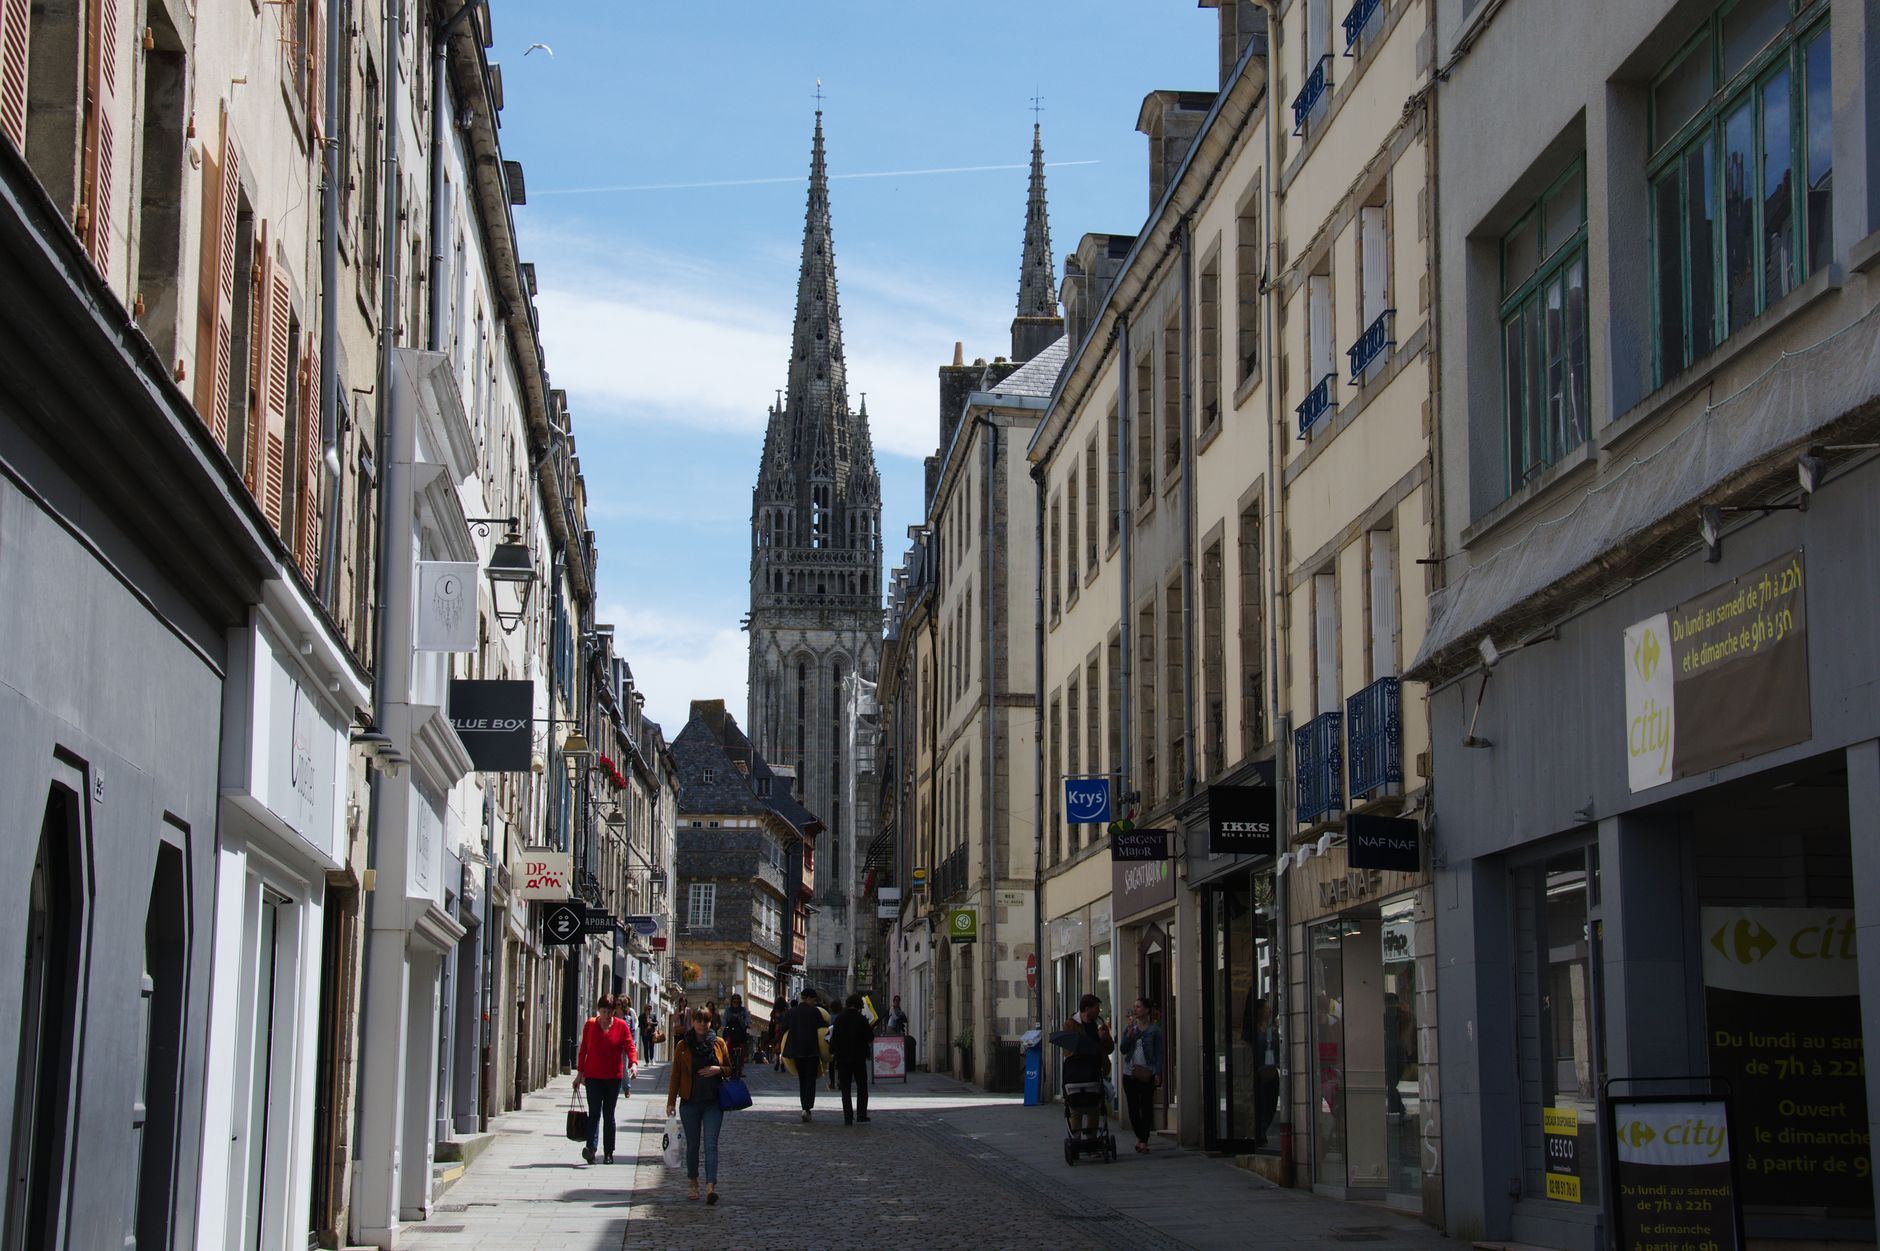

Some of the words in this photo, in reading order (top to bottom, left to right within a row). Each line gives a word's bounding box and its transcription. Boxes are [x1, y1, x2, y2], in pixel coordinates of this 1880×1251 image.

[1673, 619, 1684, 642] Du
[1685, 608, 1704, 637] lundi
[1705, 611, 1715, 628] au
[1716, 589, 1745, 624] samedi
[1746, 586, 1757, 609] de
[1758, 574, 1772, 611] 7h
[1773, 580, 1779, 597] à
[1781, 560, 1802, 594] 22h
[1682, 653, 1692, 672] et
[1691, 649, 1699, 669] le
[1700, 631, 1738, 666] dimanche
[1740, 626, 1750, 650] de
[1751, 614, 1766, 652] 9h
[1767, 616, 1773, 638] à
[492, 719, 527, 729] BOX
[1630, 698, 1670, 776] city
[1068, 790, 1103, 808] Krys
[1221, 822, 1270, 833] IKKS
[1358, 835, 1386, 848] NAF
[1388, 838, 1417, 851] NAF
[526, 876, 561, 889] am
[1319, 878, 1347, 908] NAF
[1346, 867, 1378, 899] NAF
[1714, 1031, 1744, 1048] Du
[1749, 1031, 1797, 1049] lundi
[1802, 1036, 1826, 1049] au
[1745, 1058, 1769, 1075] de
[1775, 1056, 1806, 1080] 7h
[1811, 1059, 1823, 1076] à
[1778, 1099, 1848, 1118] Ouvert
[1663, 1119, 1726, 1158] city
[1755, 1126, 1772, 1143] le
[1777, 1127, 1870, 1145] dimanche
[1549, 1138, 1574, 1159] CESCO
[1746, 1152, 1757, 1171] à
[1763, 1155, 1817, 1174] partir
[1823, 1155, 1847, 1173] de
[1638, 1184, 1667, 1196] lundi
[1671, 1187, 1684, 1196] au
[1687, 1185, 1730, 1197] samedi
[1636, 1199, 1652, 1211] de
[1654, 1199, 1672, 1213] 7h
[1676, 1200, 1683, 1211] à
[1686, 1199, 1712, 1212] 22h
[1640, 1224, 1651, 1234] le
[1654, 1224, 1711, 1235] dimanche
